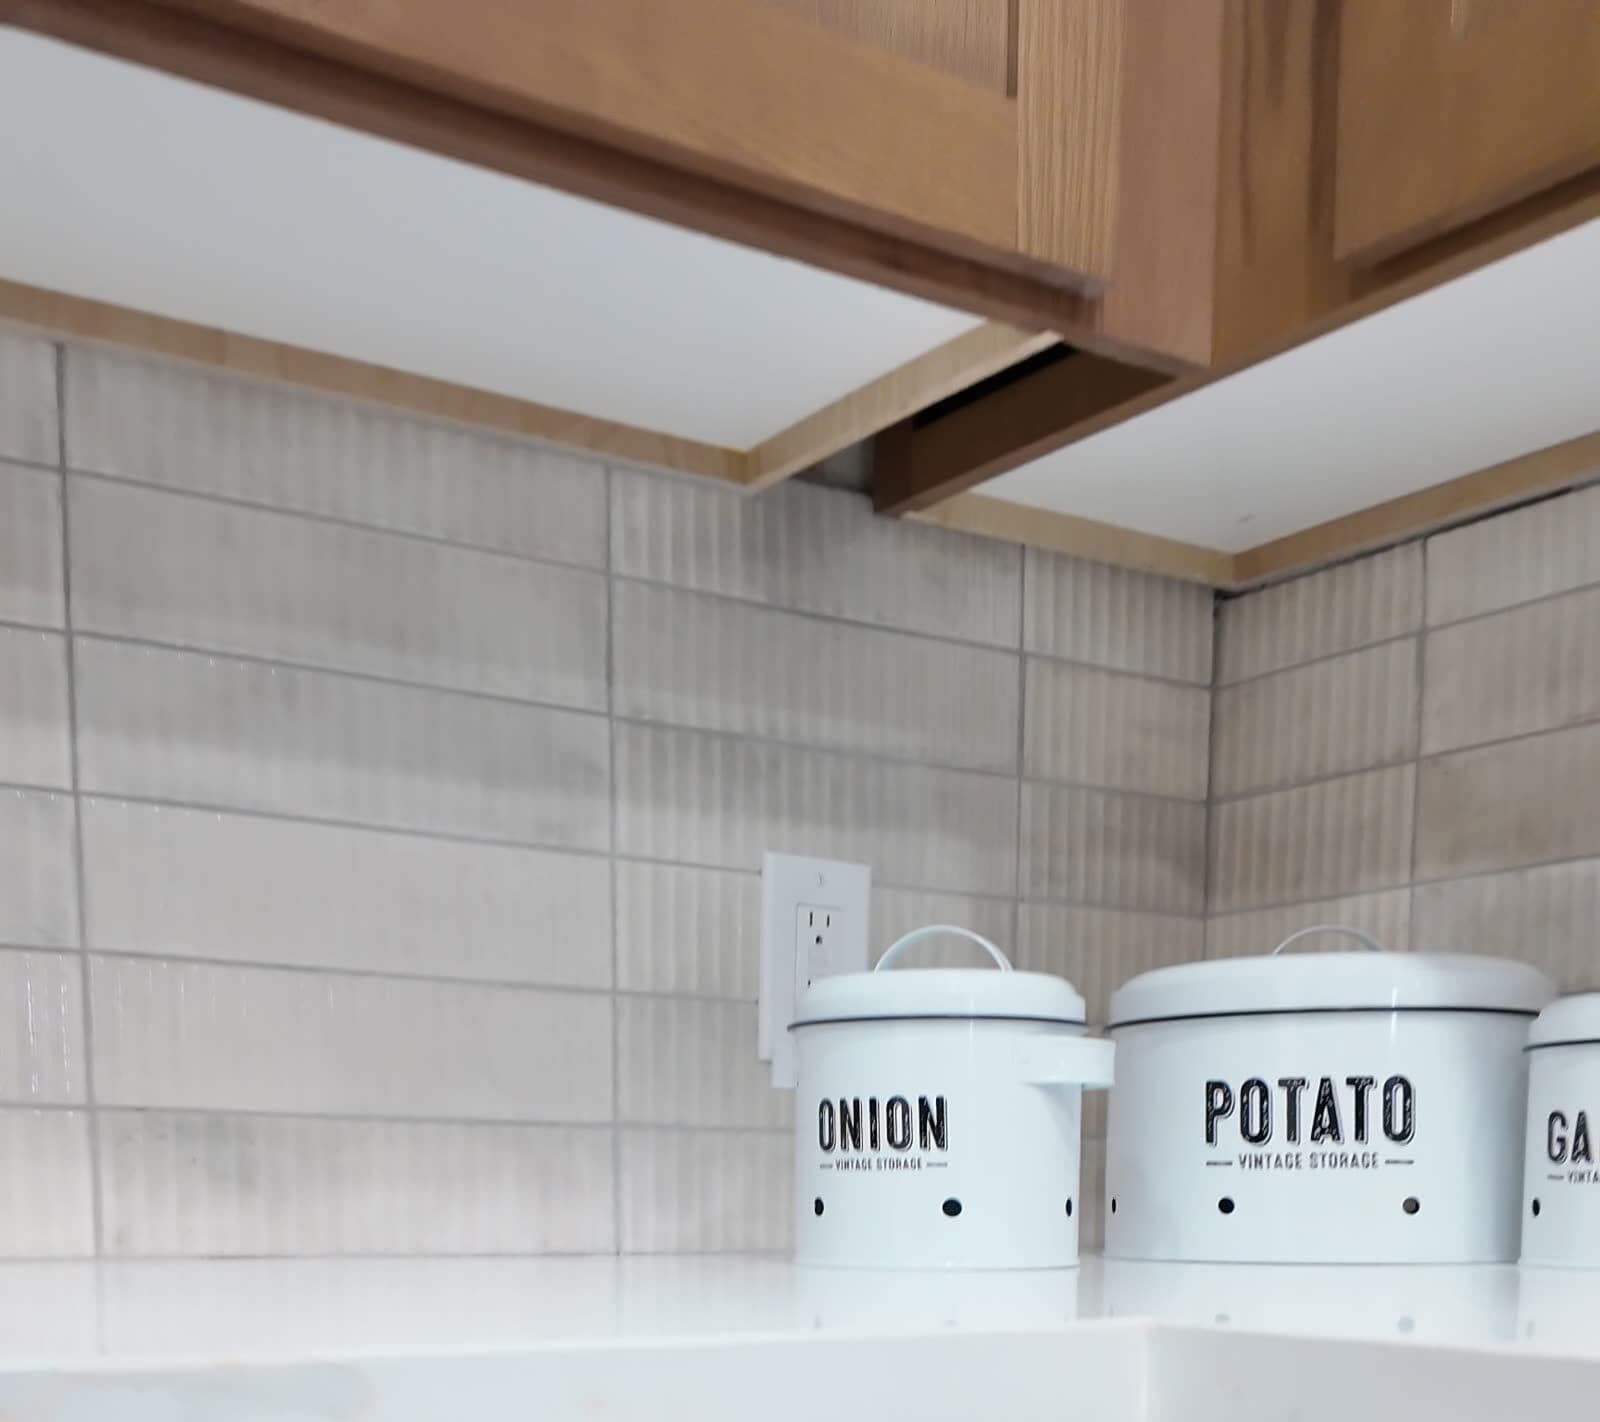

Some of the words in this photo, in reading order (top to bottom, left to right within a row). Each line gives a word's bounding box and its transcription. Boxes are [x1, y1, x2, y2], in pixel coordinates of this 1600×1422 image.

[818, 1094, 948, 1153] ONION
[1205, 1075, 1416, 1147] POTATO
[835, 1157, 873, 1171] VINTAGE
[876, 1157, 922, 1170] STORAGE
[1238, 1152, 1302, 1170] VINTAGE
[1309, 1151, 1379, 1169] STORAGE
